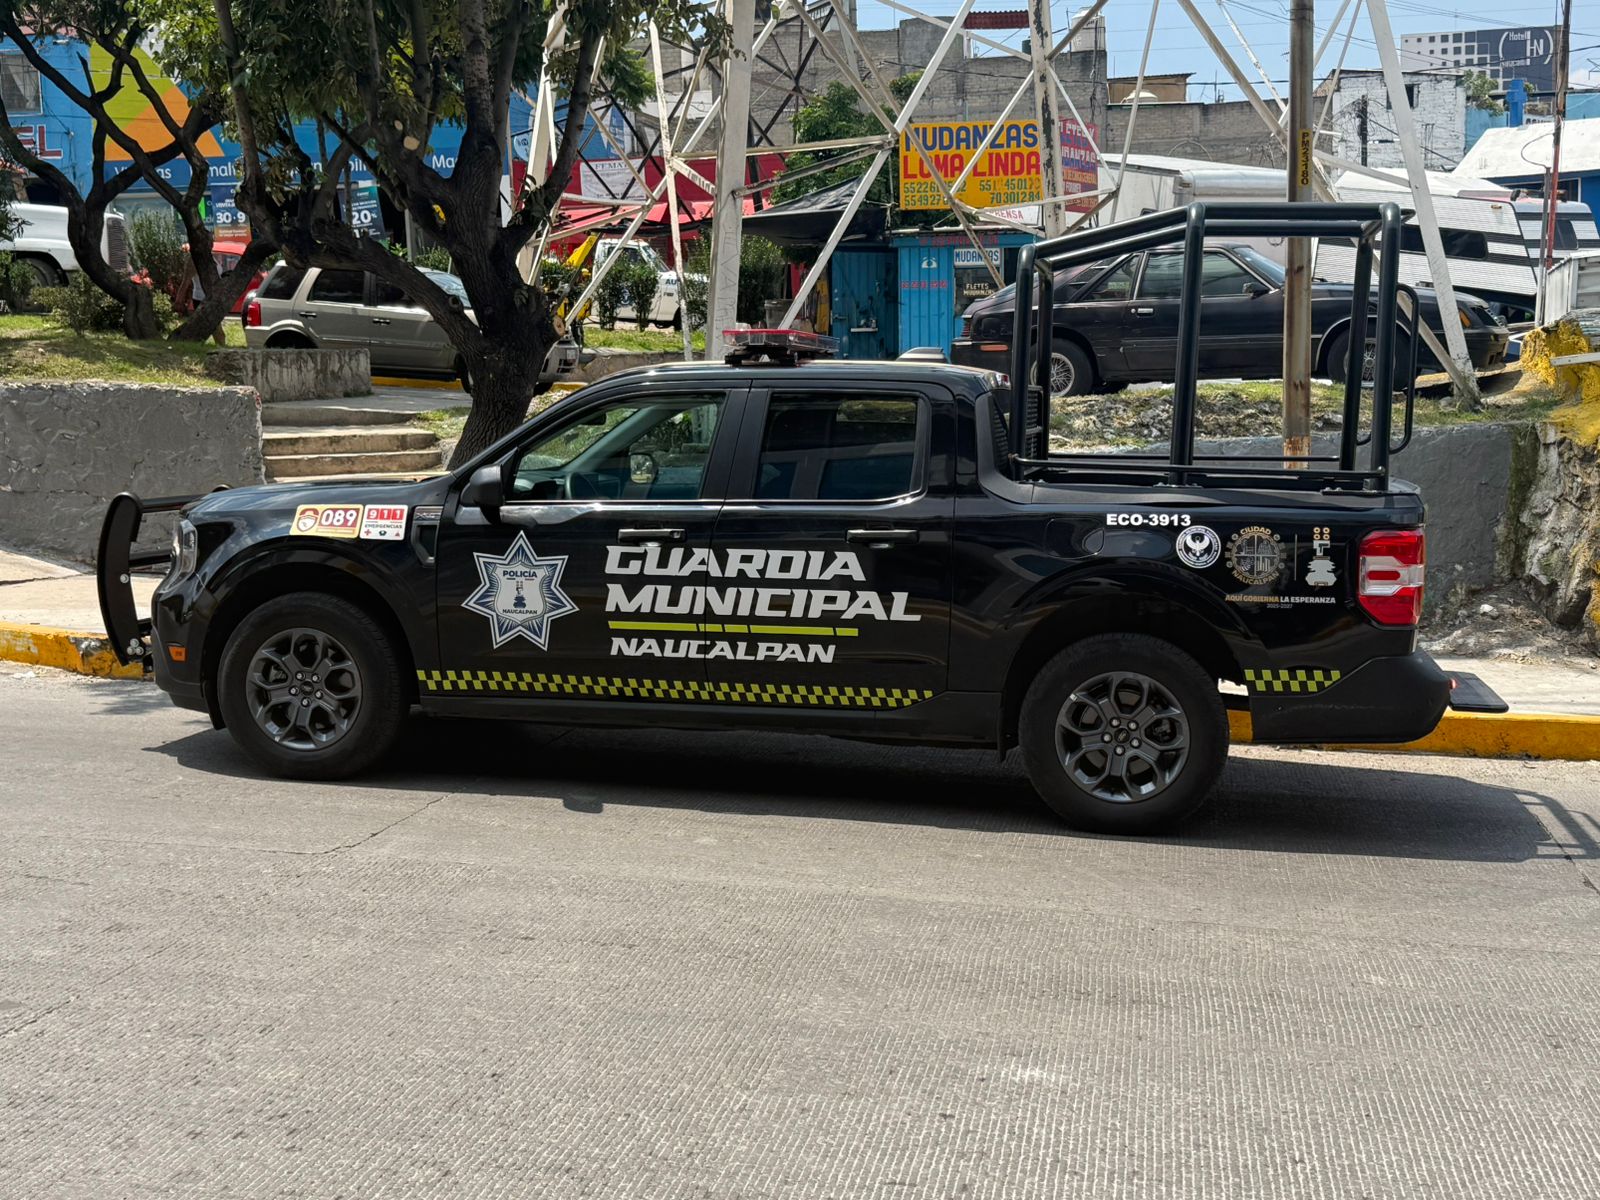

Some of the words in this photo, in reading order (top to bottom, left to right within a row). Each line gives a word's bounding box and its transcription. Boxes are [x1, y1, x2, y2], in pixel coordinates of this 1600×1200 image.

[1509, 31, 1527, 41] Hotel
[905, 123, 1039, 152] MUDANZAS
[972, 151, 1041, 178] LINDA
[320, 509, 358, 527] 089
[367, 509, 403, 520] 911
[1106, 513, 1191, 527] ECO-3913
[1240, 525, 1272, 536] CIUDAD
[604, 545, 867, 582] GUARDIA
[502, 569, 538, 578] POLICÍA
[1231, 569, 1280, 586] NAUCALPAN
[604, 583, 922, 622] MUNICIPAL
[1243, 594, 1279, 603] GOBIERNA
[1280, 595, 1290, 604] LA
[1290, 596, 1336, 604] ESPERANZA
[610, 637, 837, 664] NAUCALPAN
